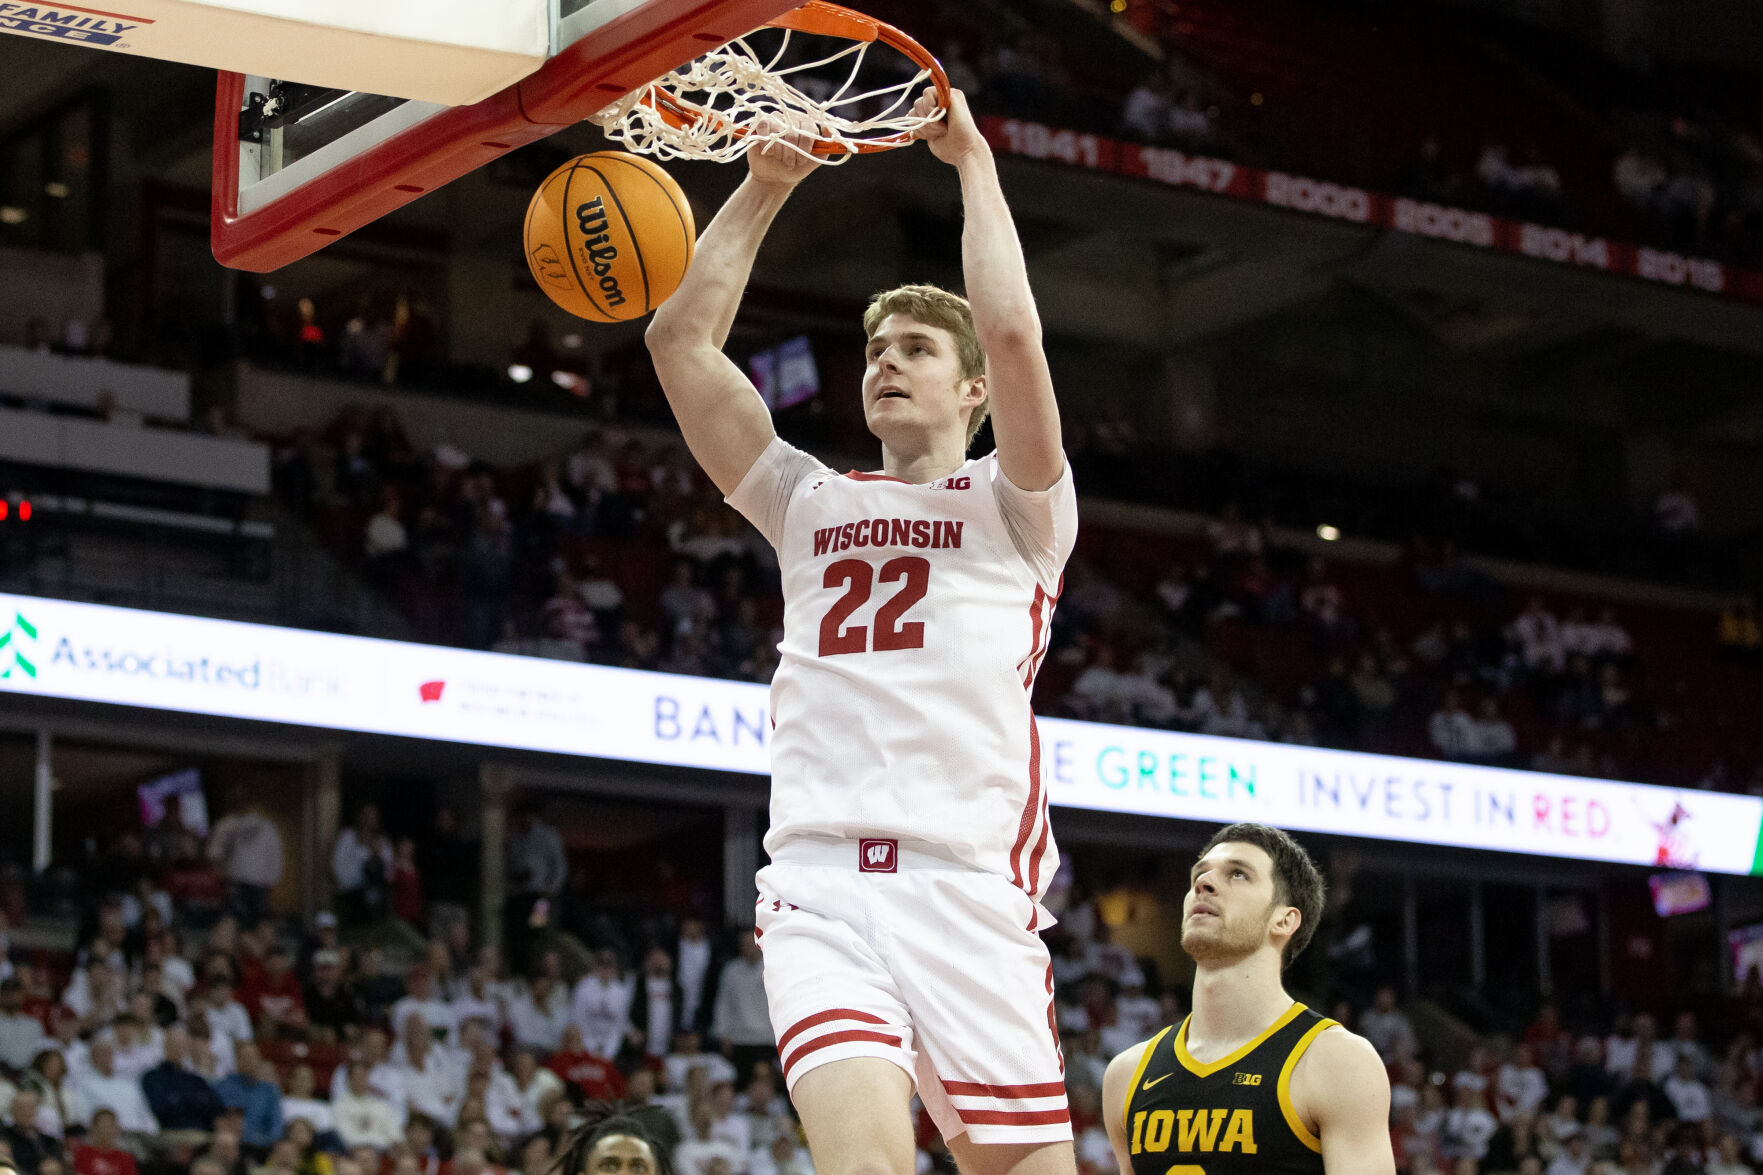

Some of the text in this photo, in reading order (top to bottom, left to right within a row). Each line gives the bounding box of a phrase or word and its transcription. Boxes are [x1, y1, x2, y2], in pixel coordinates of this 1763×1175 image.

[0, 3, 138, 34] FAMILY
[576, 194, 627, 308] Wilson
[813, 518, 963, 557] WISCONSIN
[818, 556, 930, 657] 22
[50, 634, 262, 690] Associated
[654, 695, 766, 748] BAN
[1294, 769, 1453, 823] INVEST
[1474, 788, 1516, 826] IN
[1131, 1108, 1257, 1155] IOWA
